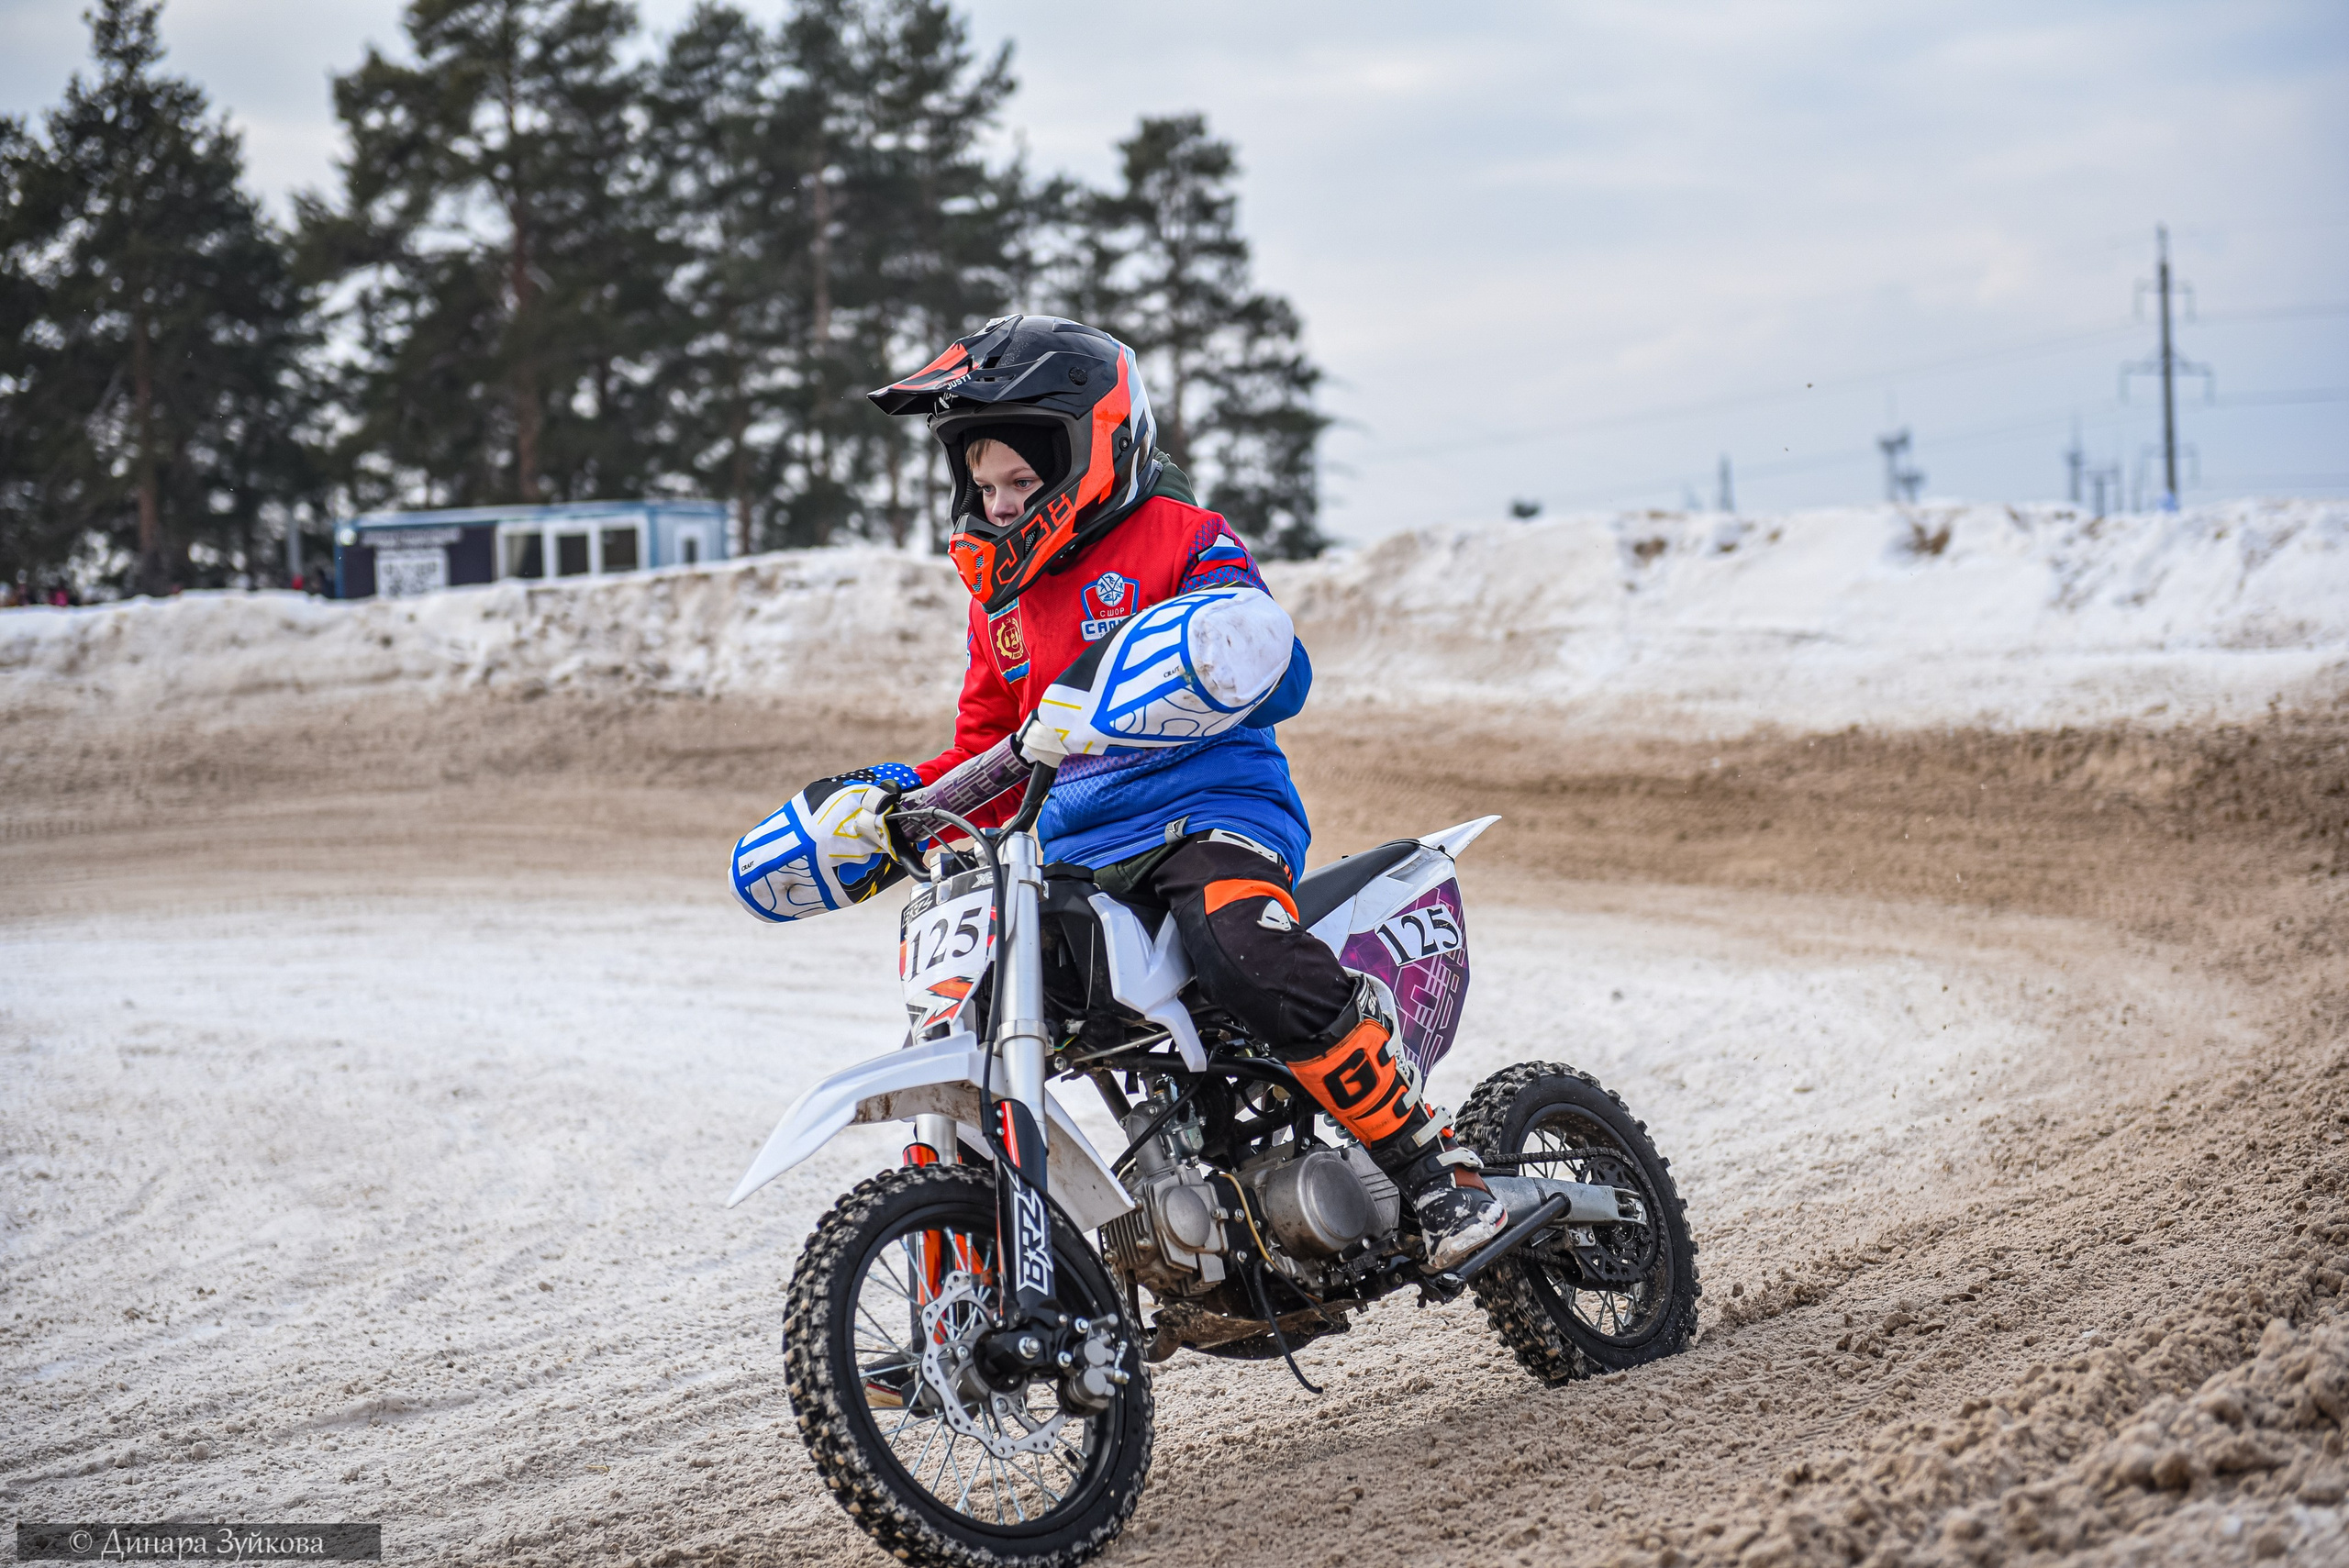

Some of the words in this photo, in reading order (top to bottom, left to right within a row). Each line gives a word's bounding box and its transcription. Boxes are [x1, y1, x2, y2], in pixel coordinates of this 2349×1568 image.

[1099, 607, 1125, 617] СШОР
[907, 906, 983, 983] 125
[1376, 906, 1459, 965] 125
